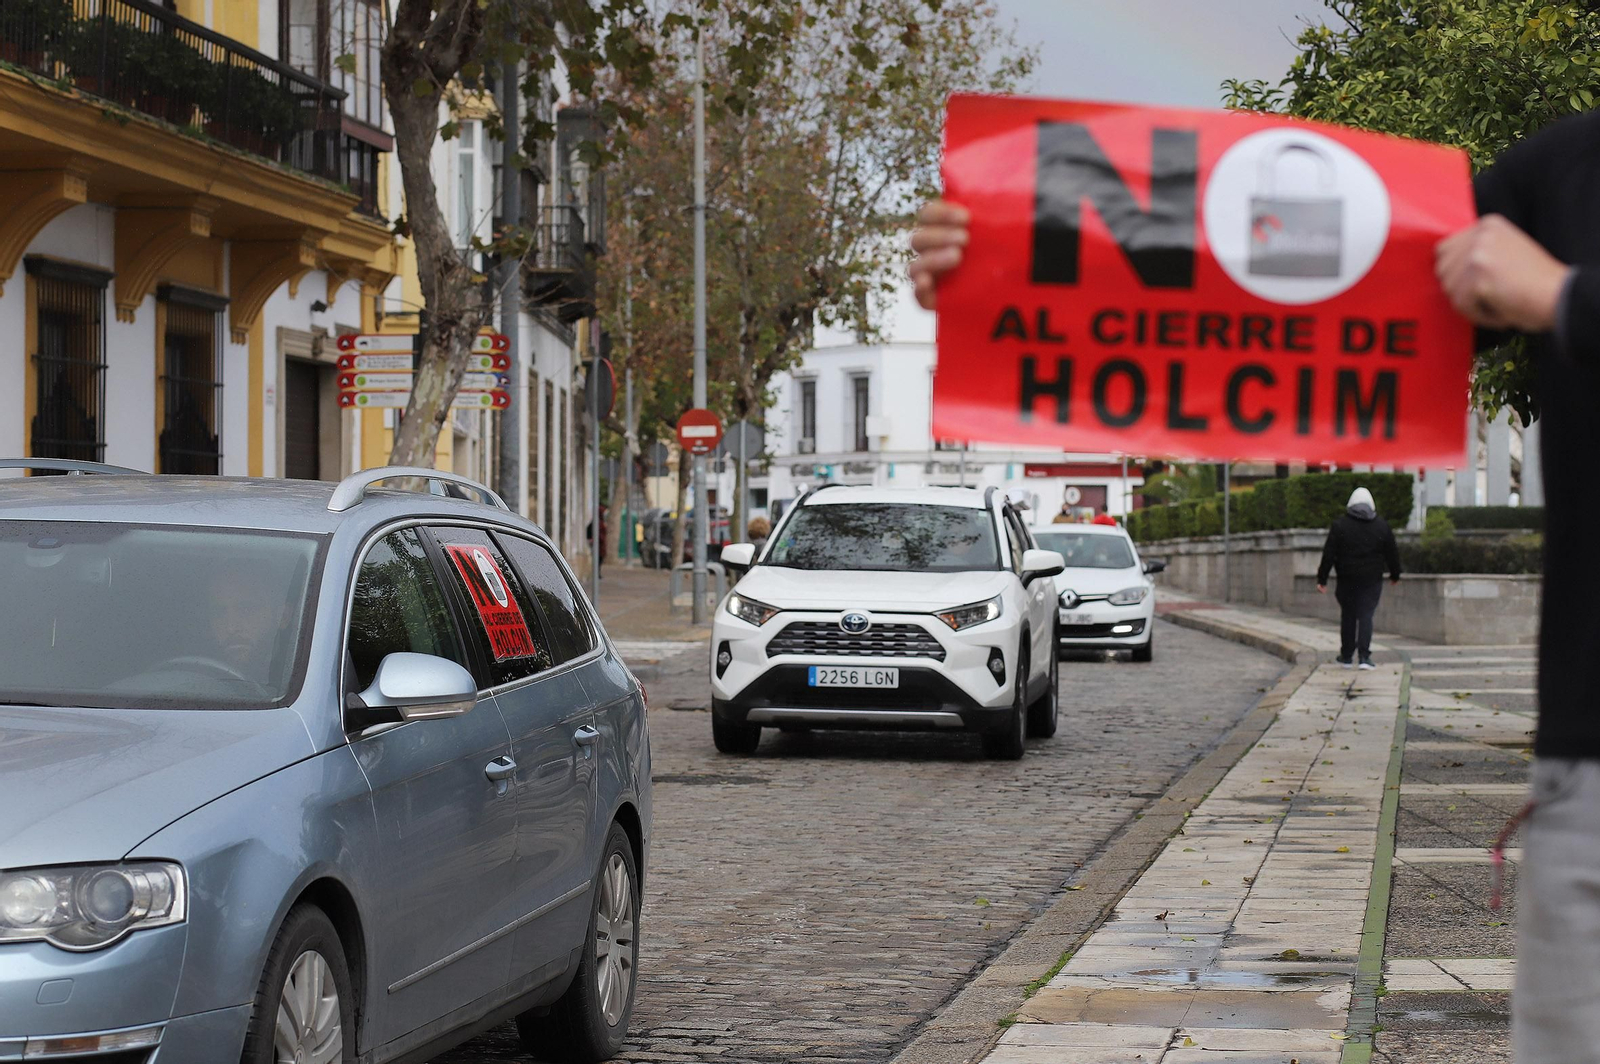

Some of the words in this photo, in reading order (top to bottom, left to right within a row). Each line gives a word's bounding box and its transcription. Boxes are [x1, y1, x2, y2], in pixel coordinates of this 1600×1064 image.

[991, 307, 1066, 342] AL
[1091, 308, 1316, 352] CIERRE
[1341, 319, 1418, 356] DE
[1019, 355, 1400, 439] HOLCIM
[483, 613, 494, 626] AL
[492, 613, 514, 625] CIERRE
[512, 612, 523, 625] DE
[492, 628, 531, 655] HOLCIM
[819, 669, 859, 685] 2256
[865, 671, 894, 685] LGN
